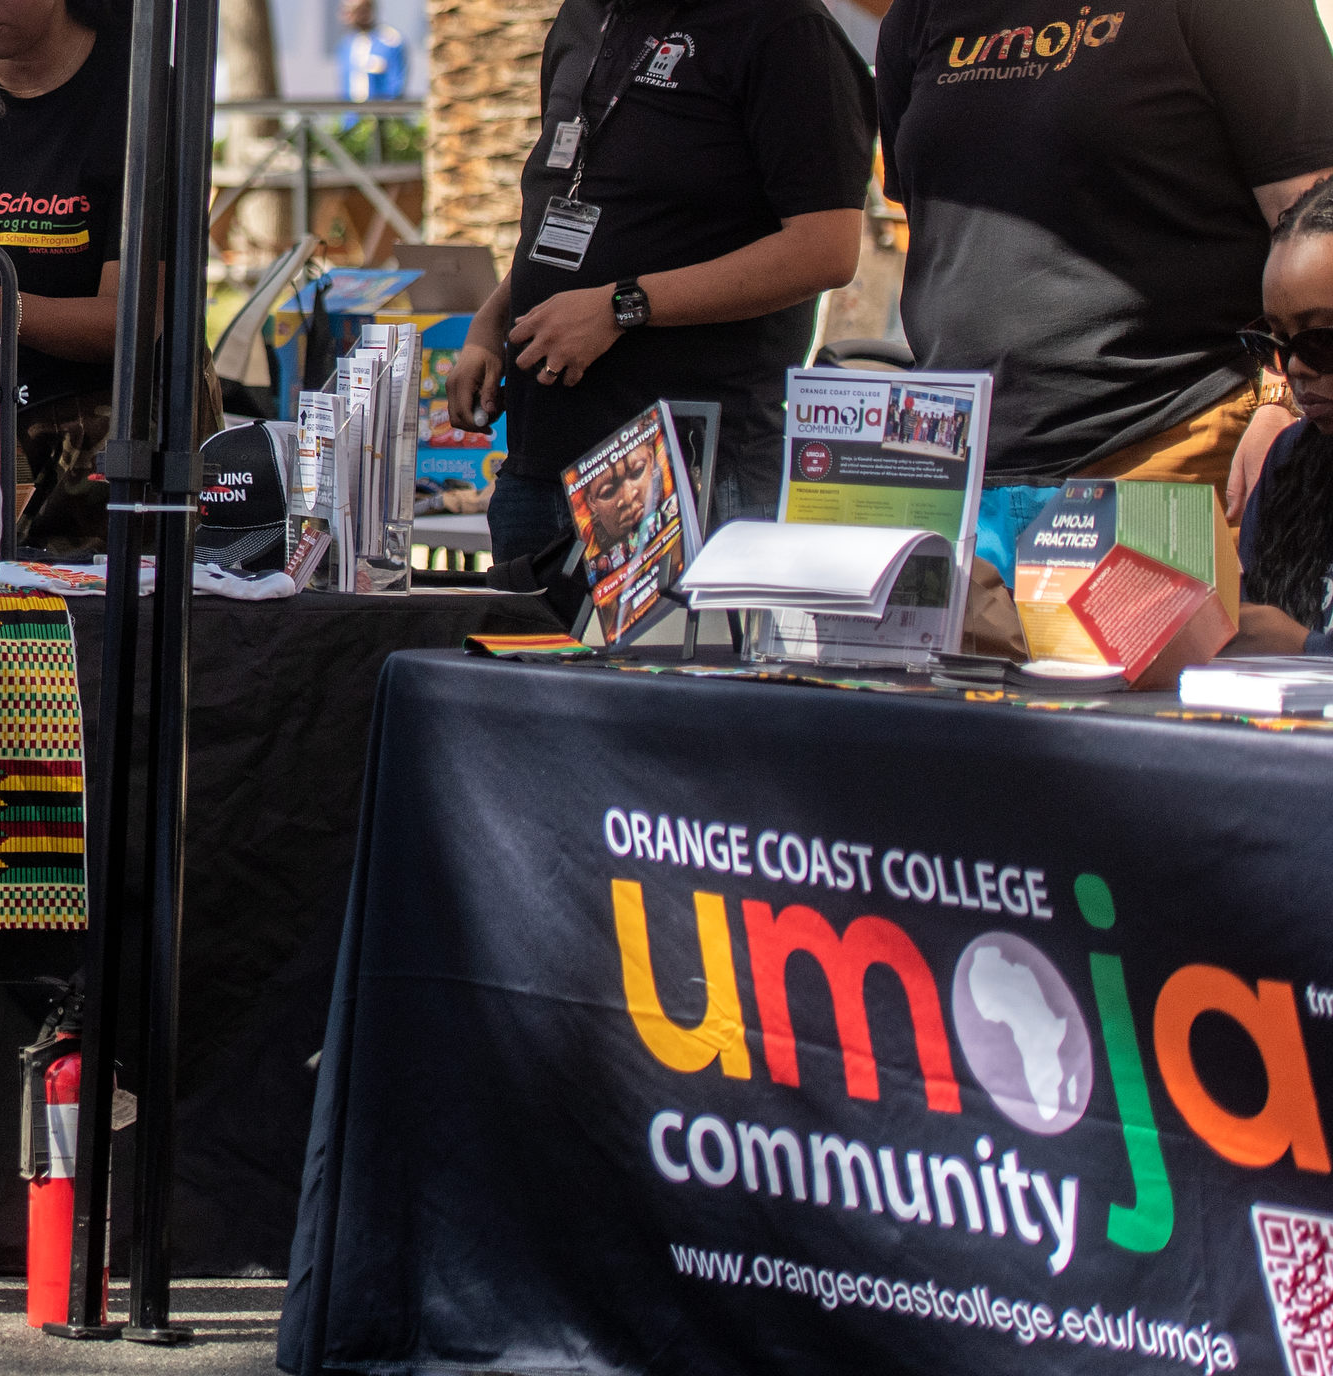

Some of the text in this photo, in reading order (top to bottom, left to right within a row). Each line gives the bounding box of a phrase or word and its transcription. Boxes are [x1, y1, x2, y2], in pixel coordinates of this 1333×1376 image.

[948, 5, 1126, 72] umoja
[635, 76, 679, 89] OUTREACH
[937, 61, 1050, 86] community
[853, 390, 881, 398] COLLEGE
[796, 398, 882, 433] umoja
[798, 424, 856, 435] COMMUNITY
[1052, 514, 1095, 529] UMOJA
[1034, 531, 1099, 548] PRACTICES
[605, 808, 1053, 918] ORANGE COAST COLLEGE
[611, 874, 1332, 1254] umoja
[649, 1111, 1079, 1276] community
[670, 1243, 1236, 1374] www.orangecoastcollege.edu/umoja
